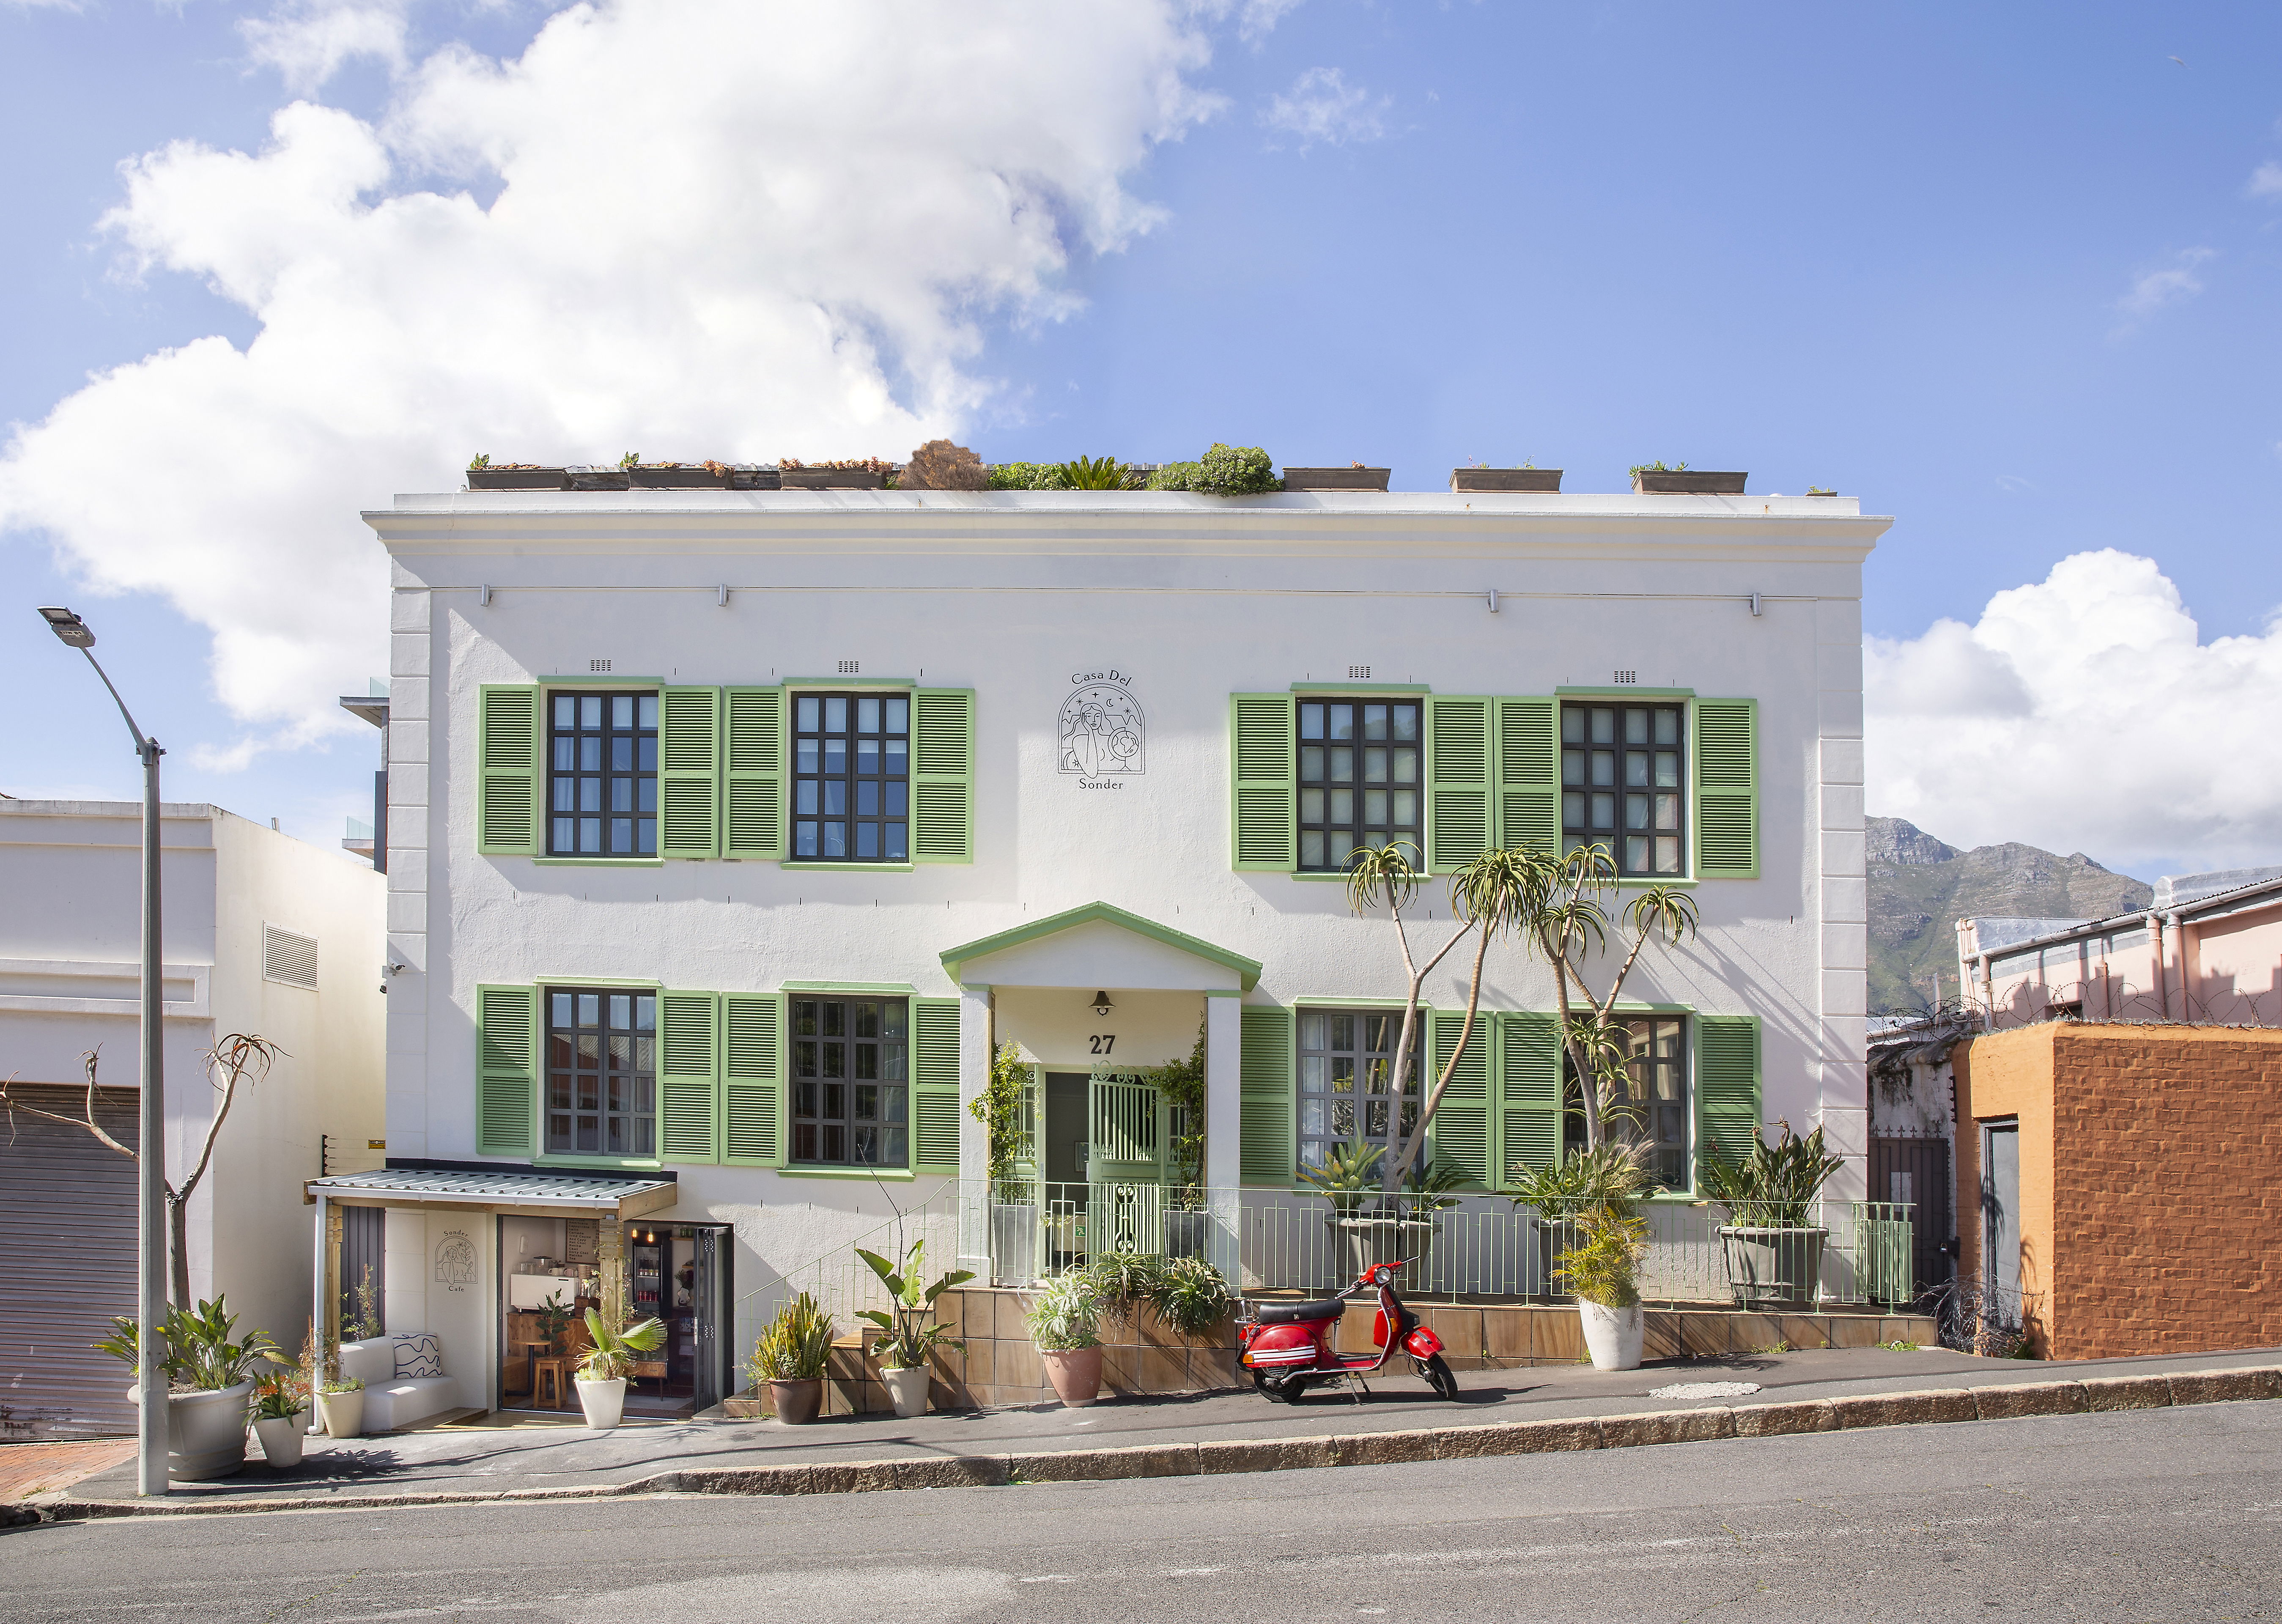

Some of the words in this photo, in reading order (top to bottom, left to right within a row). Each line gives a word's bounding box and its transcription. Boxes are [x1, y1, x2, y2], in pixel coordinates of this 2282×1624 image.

[1071, 672, 1103, 684] Casa
[1108, 670, 1132, 686] Del
[1079, 778, 1123, 790] Sonder
[1089, 1035, 1116, 1054] 27
